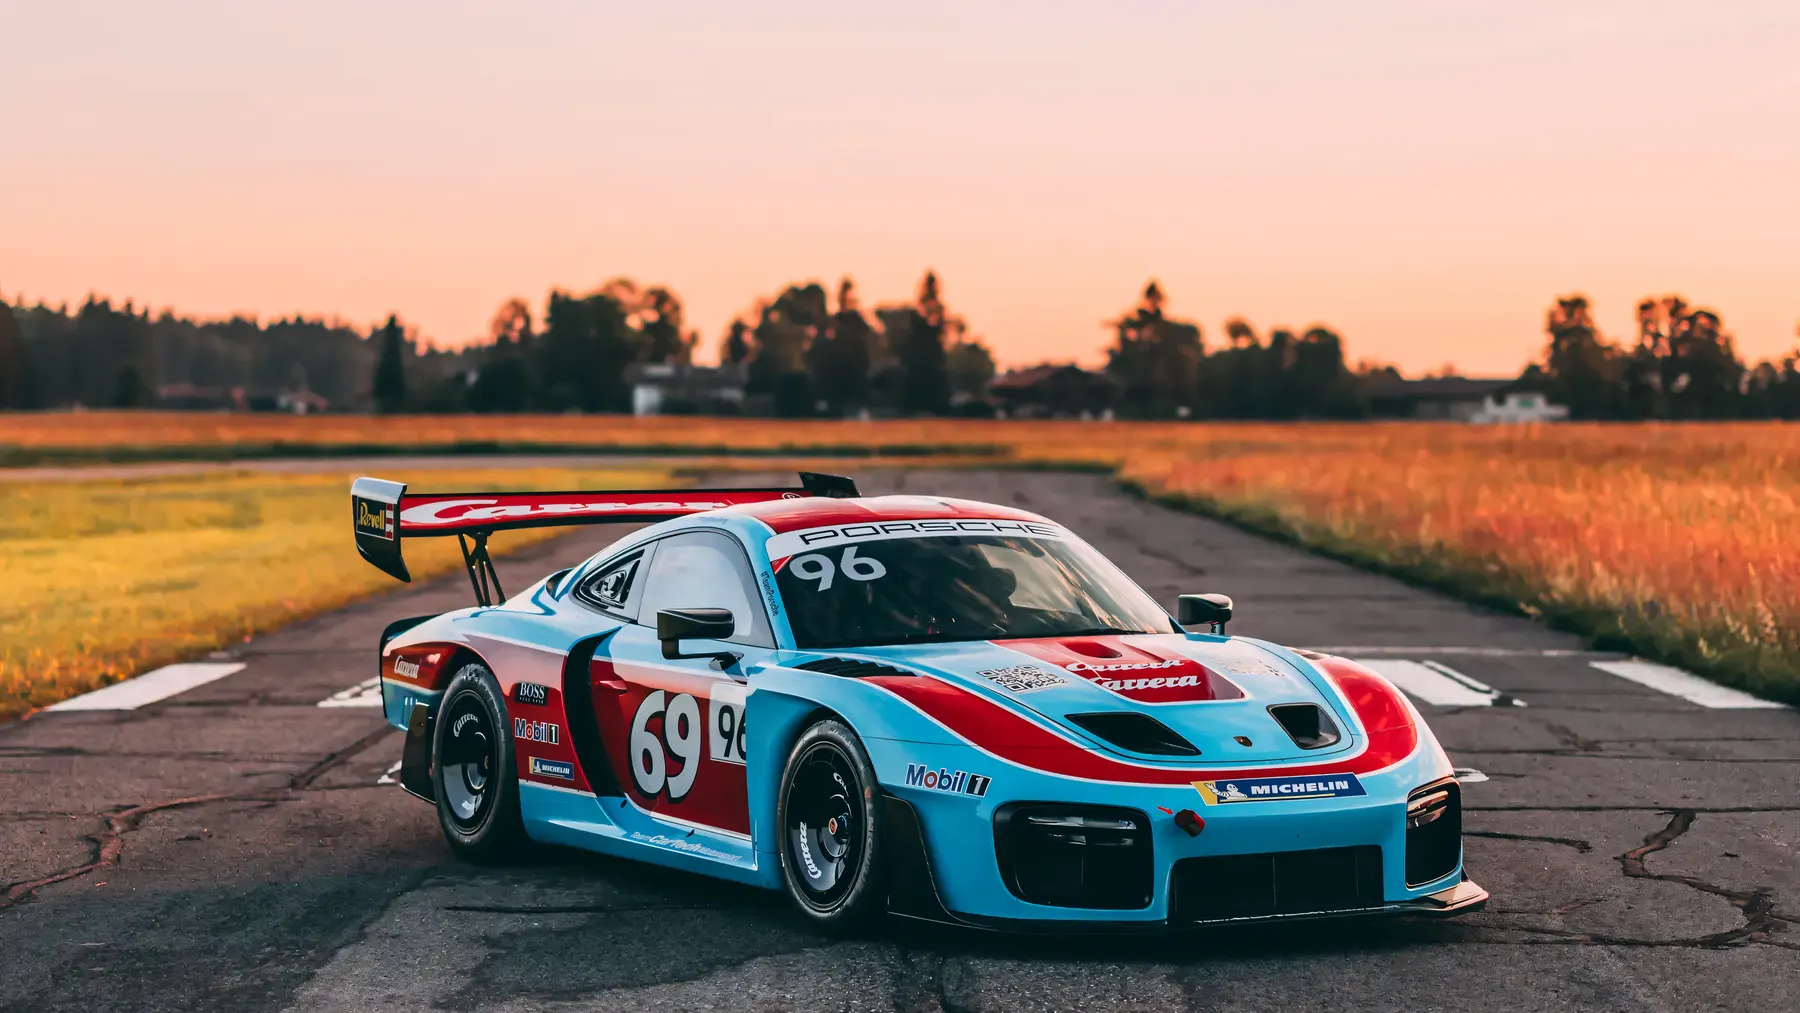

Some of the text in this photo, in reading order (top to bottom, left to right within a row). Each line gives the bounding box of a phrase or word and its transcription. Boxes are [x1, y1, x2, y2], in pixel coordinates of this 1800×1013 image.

[360, 501, 385, 531] Revell
[400, 499, 734, 524] Carrer
[799, 521, 1061, 546] PORSCHE
[789, 545, 887, 592] 96
[1065, 659, 1184, 672] Carrera
[520, 682, 545, 699] BOSS
[514, 717, 547, 743] Mobil
[718, 704, 746, 761] 96
[629, 689, 701, 803] 69
[541, 764, 570, 775] MICHELIN
[905, 763, 990, 797] Mobil 1
[1250, 780, 1350, 795] MICHELIN
